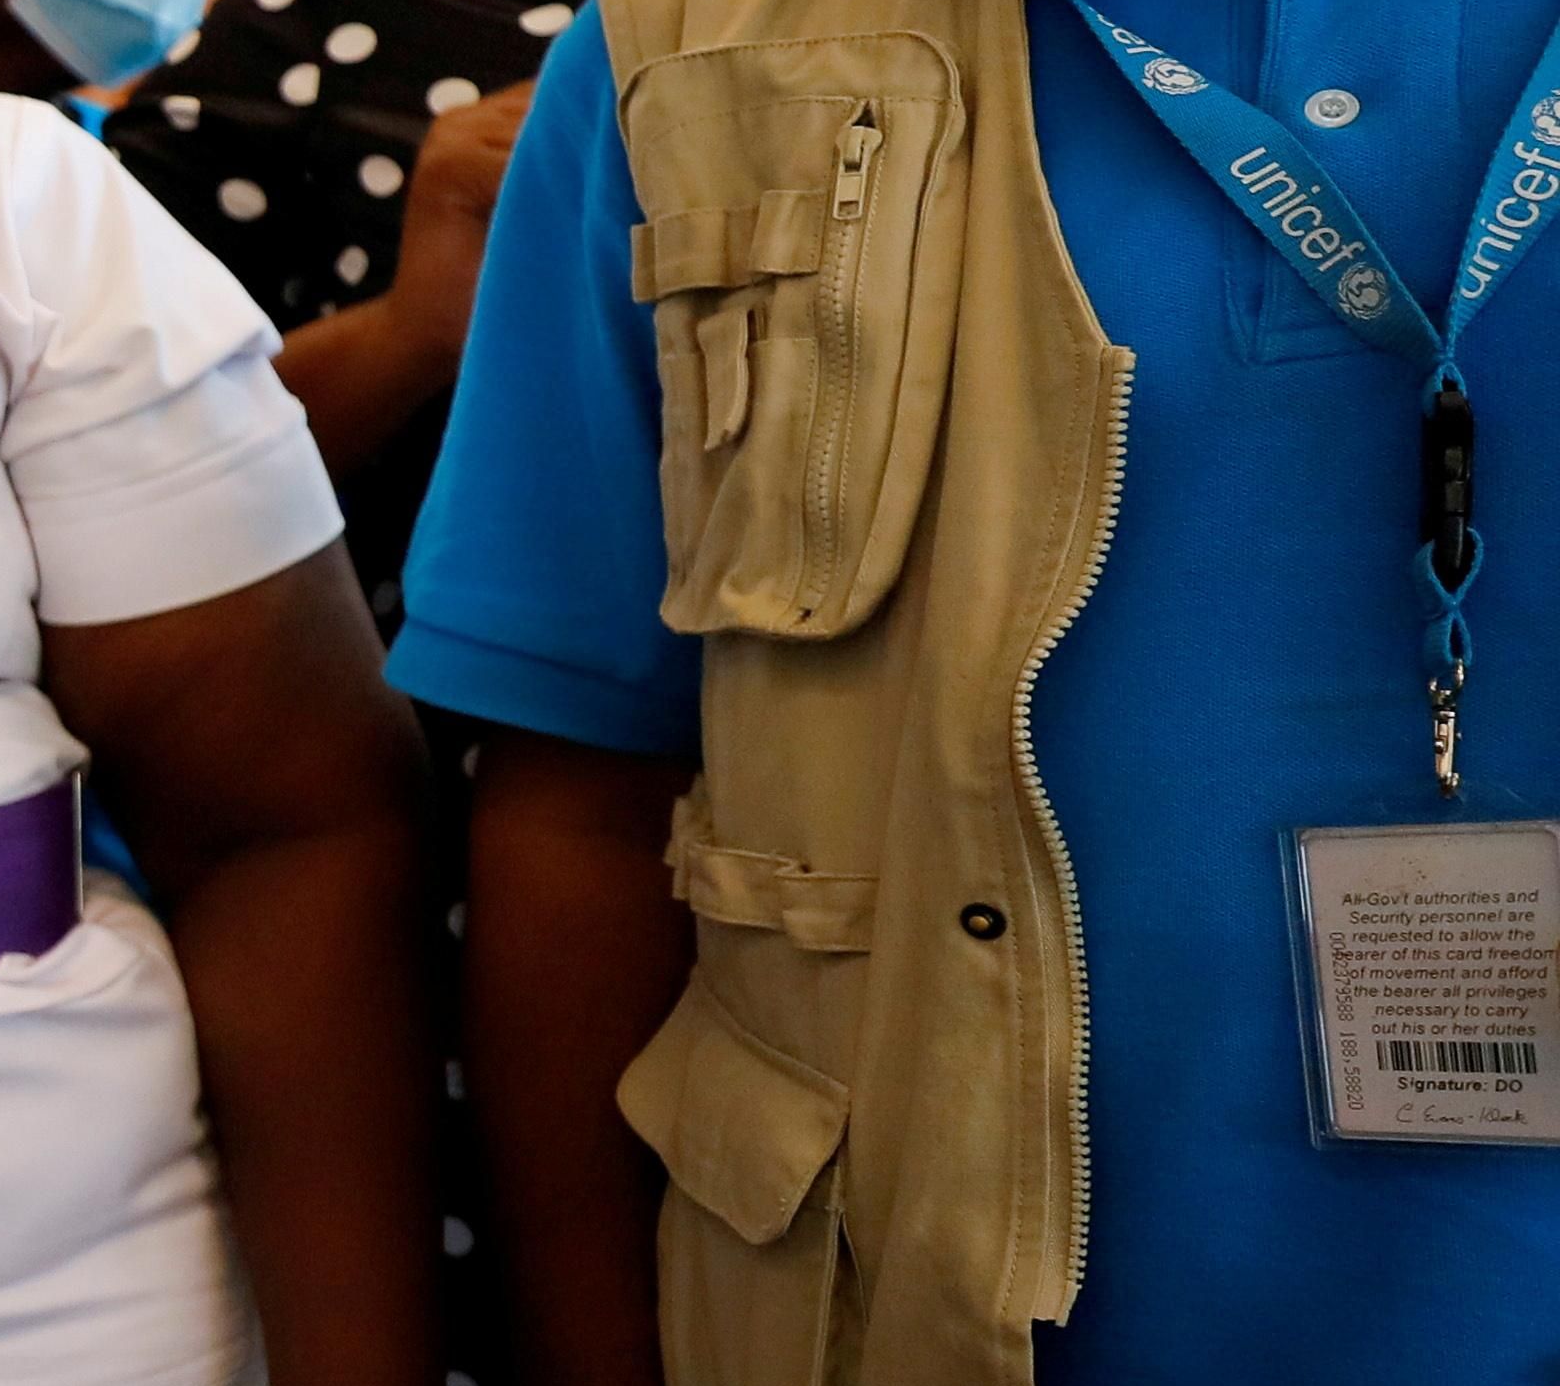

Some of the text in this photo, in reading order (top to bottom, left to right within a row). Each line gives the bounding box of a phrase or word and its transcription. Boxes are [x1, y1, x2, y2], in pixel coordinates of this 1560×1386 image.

[1230, 146, 1366, 272] unicef
[1460, 141, 1560, 299] unicef
[1414, 890, 1501, 905] authorities
[1506, 889, 1540, 904] and
[1349, 910, 1535, 926] Security personnel are
[1352, 929, 1536, 944] requested to allow the
[1391, 947, 1408, 960] of
[1412, 948, 1441, 960] this
[1446, 947, 1482, 960] card
[1350, 966, 1548, 979] of movement and afford
[1354, 984, 1548, 1000] the bearer all privileges
[1375, 1003, 1529, 1018] necessary to carry
[1372, 1021, 1537, 1036] out his or her duties
[1397, 1076, 1524, 1093] Signature: DO
